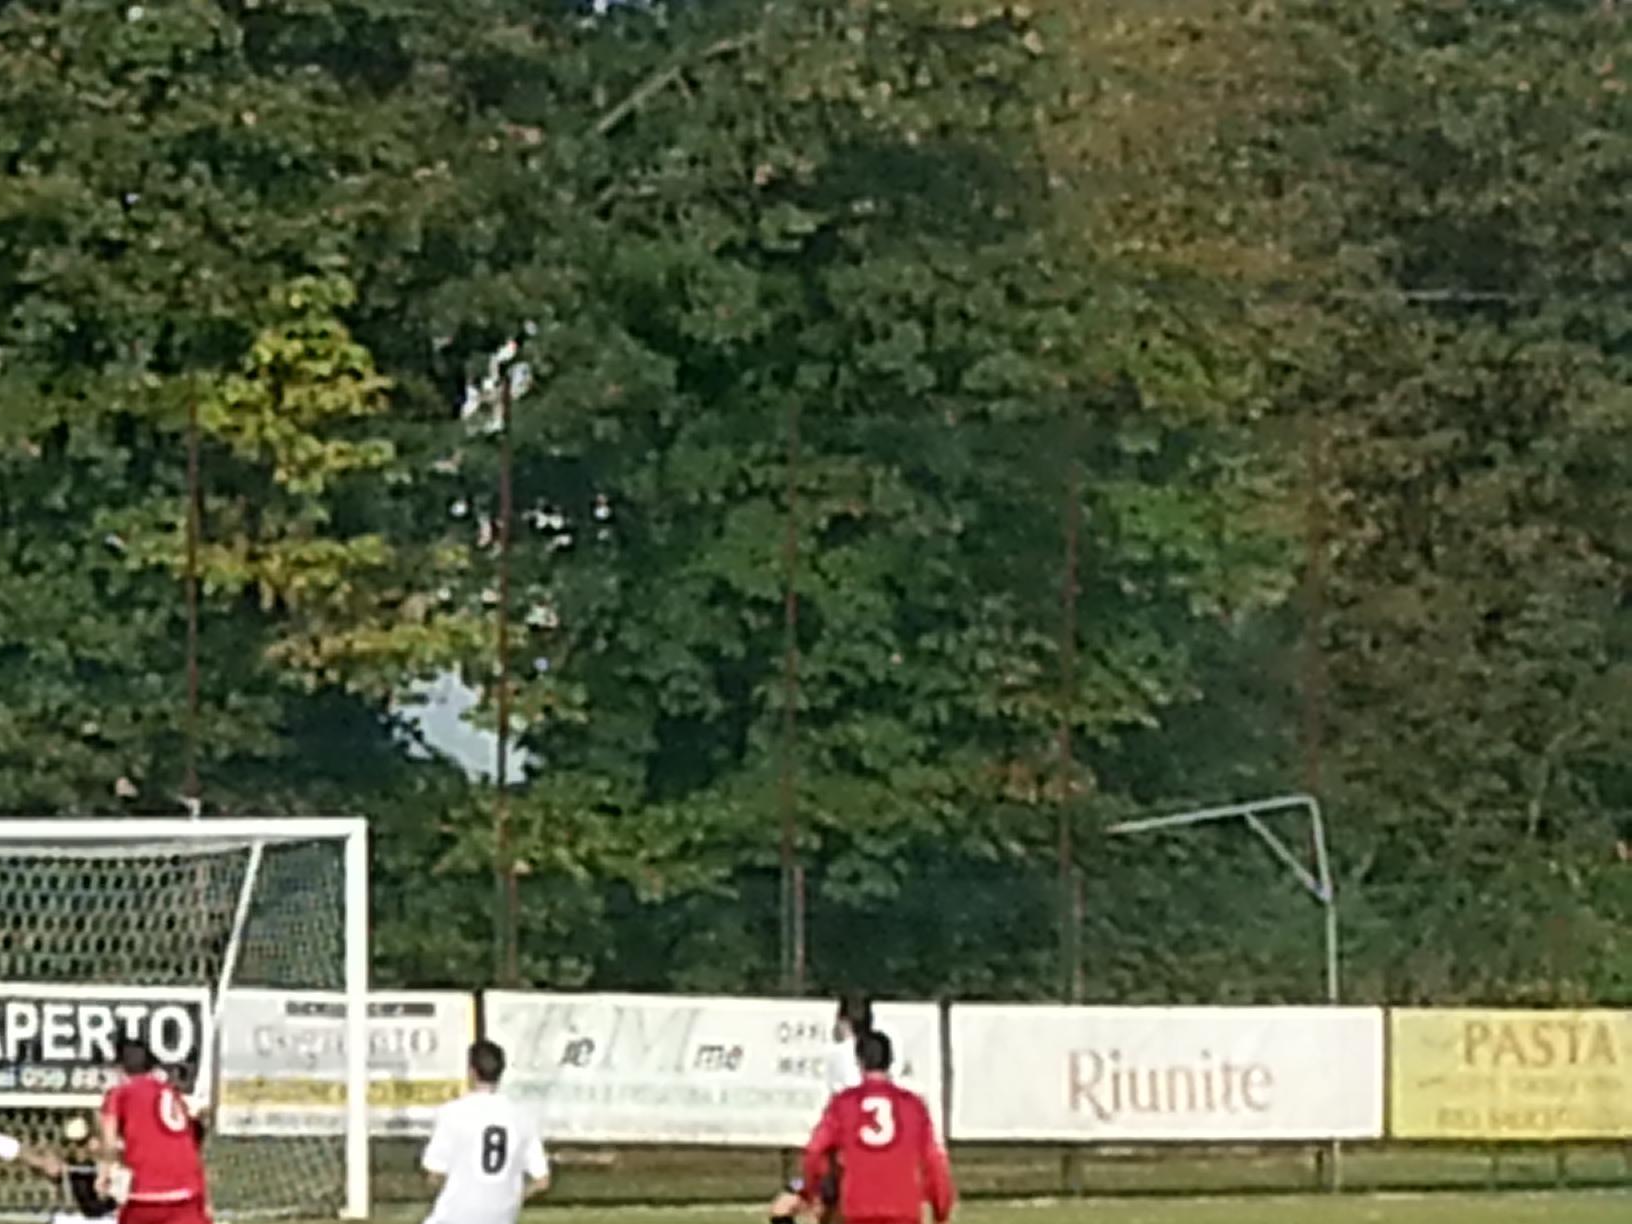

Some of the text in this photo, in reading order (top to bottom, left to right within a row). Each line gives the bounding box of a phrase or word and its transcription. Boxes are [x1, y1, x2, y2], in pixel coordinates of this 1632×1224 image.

[1463, 1019, 1617, 1068] PASTA
[1066, 1047, 1274, 1121] Riunite
[859, 1096, 895, 1146] 3
[482, 1124, 509, 1174] 8
